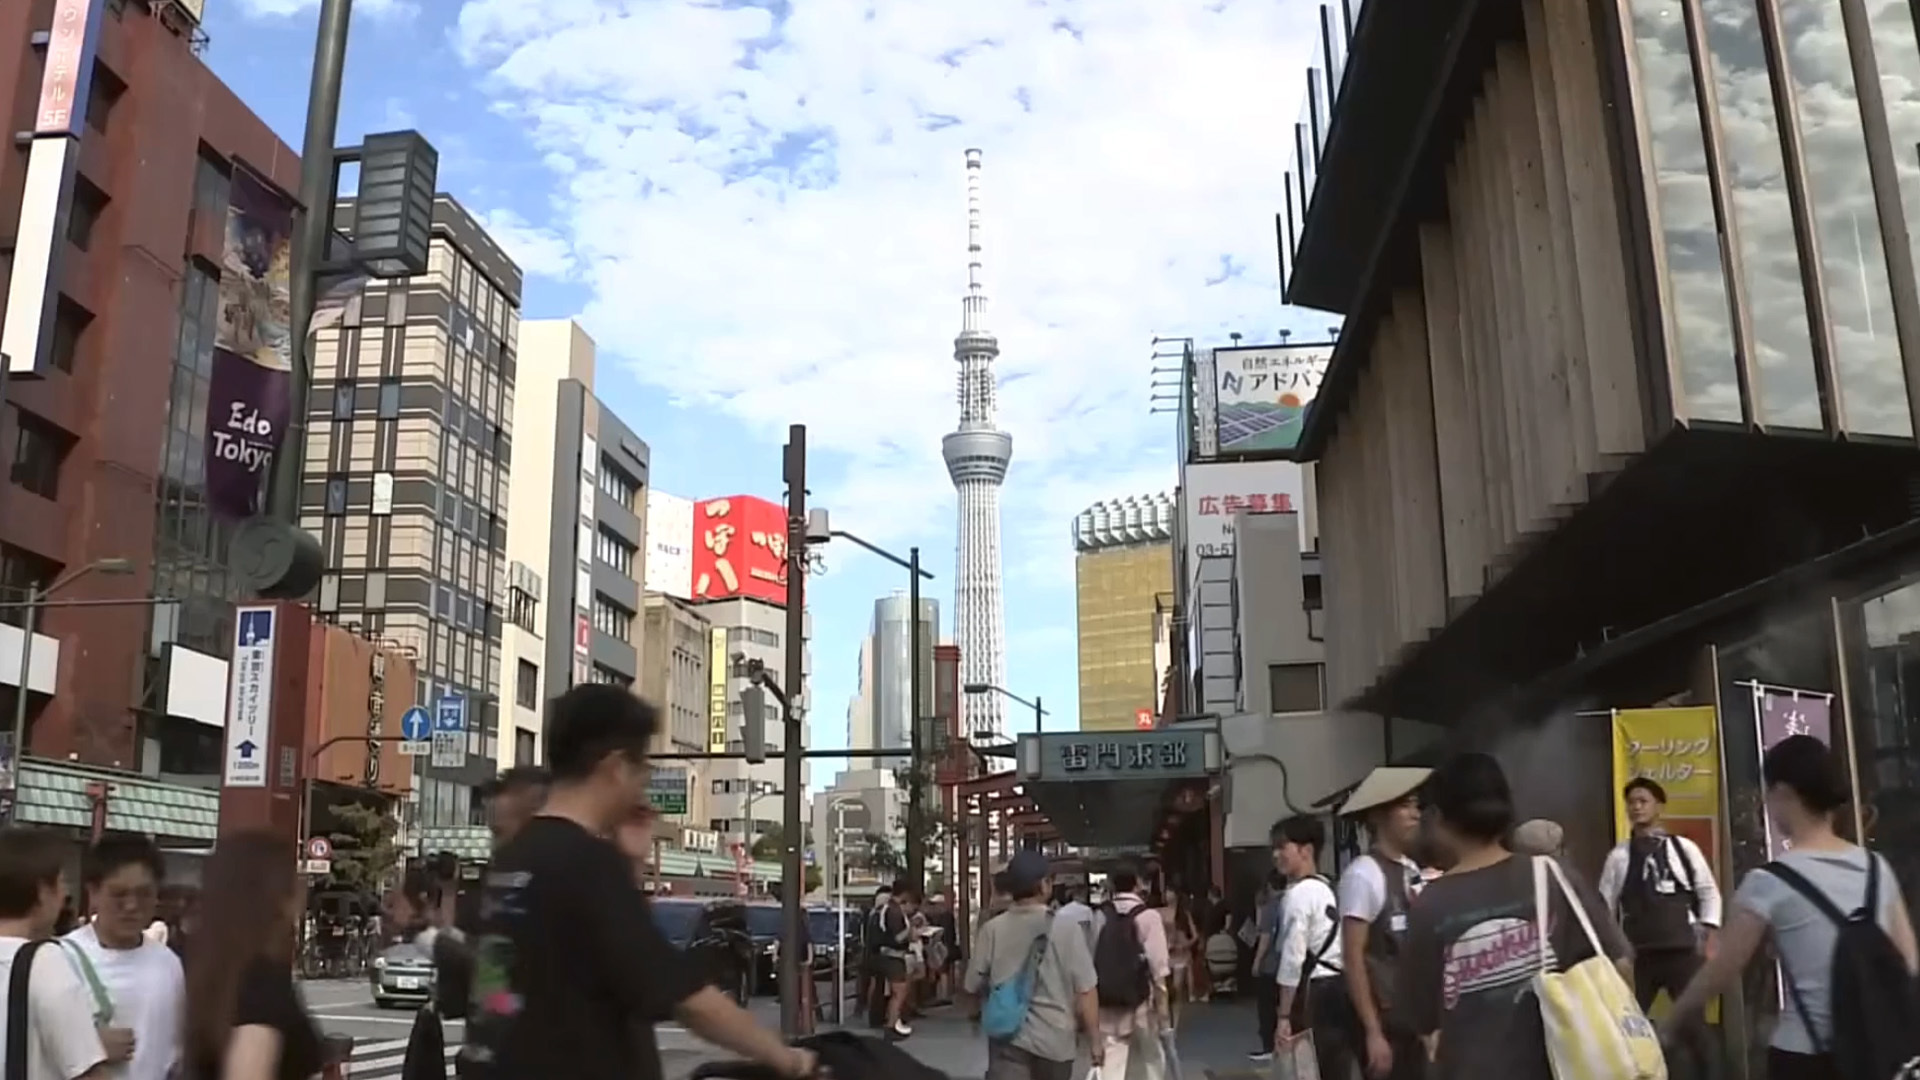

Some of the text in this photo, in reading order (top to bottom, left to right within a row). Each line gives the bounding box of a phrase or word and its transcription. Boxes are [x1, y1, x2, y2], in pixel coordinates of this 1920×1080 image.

[43, 110, 67, 126] 5F
[1242, 354, 1328, 370] 自然エネルギー
[227, 401, 271, 435] Edo
[1198, 493, 1293, 516] 広告募集
[1138, 711, 1152, 725] 丸
[1061, 740, 1187, 771] 雷門東部
[1628, 737, 1710, 755] クーリング
[1627, 761, 1713, 781] シェルター
